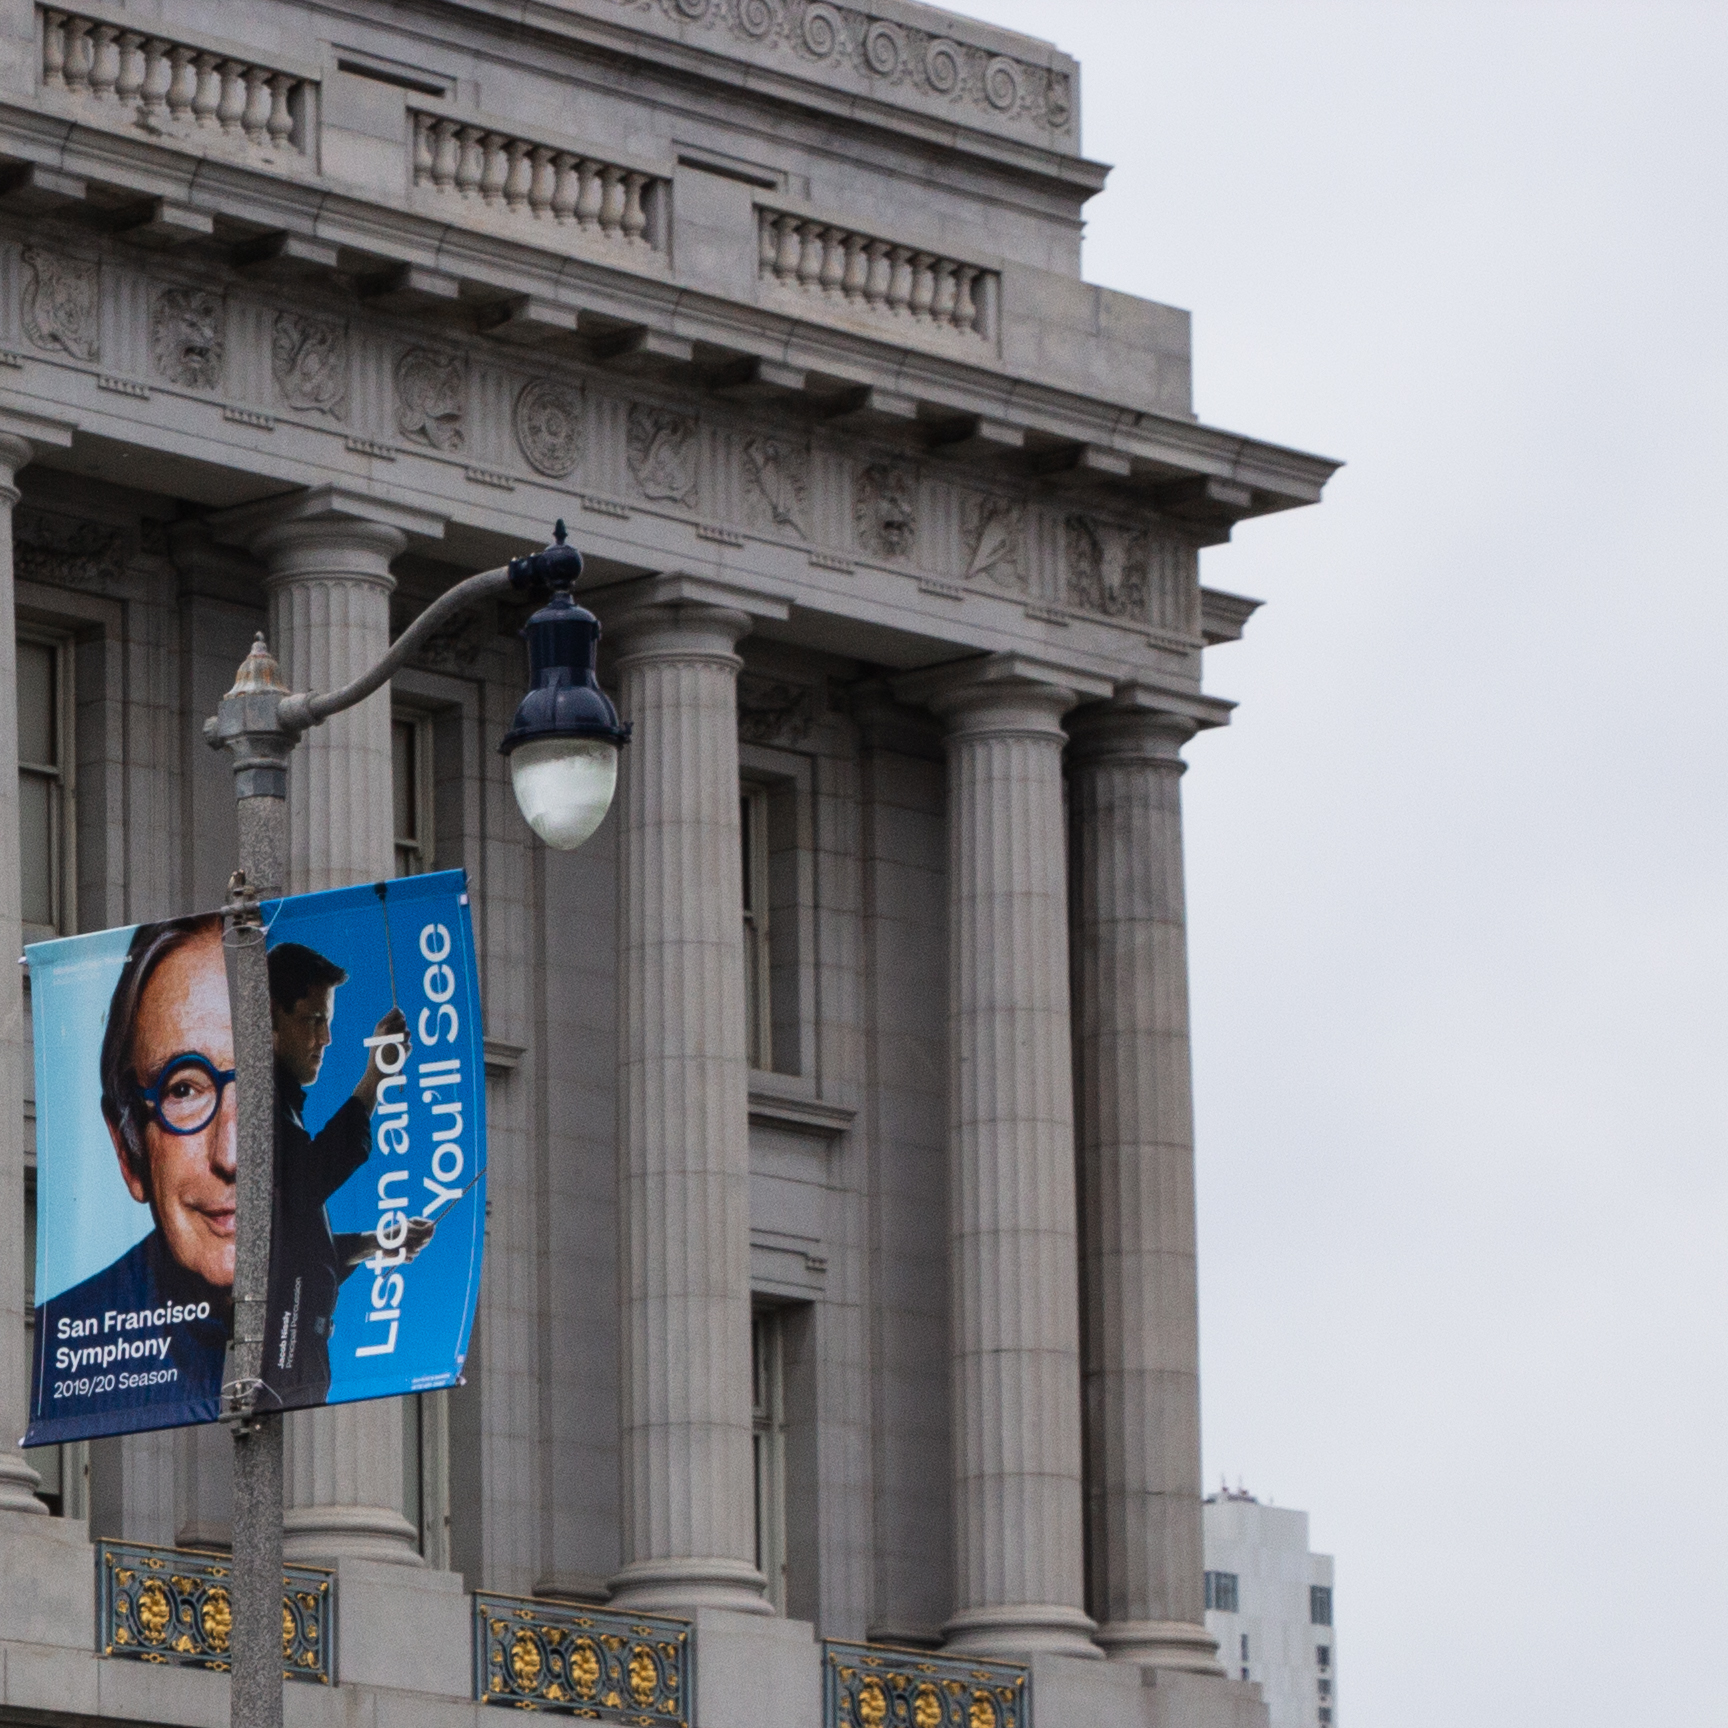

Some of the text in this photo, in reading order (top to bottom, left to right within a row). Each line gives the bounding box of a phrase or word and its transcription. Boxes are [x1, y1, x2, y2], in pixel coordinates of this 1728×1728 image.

[418, 923, 464, 1218] You'll See
[355, 1033, 411, 1358] Listen and
[56, 1300, 211, 1341] San Francisco
[55, 1335, 172, 1372] Symphony
[53, 1366, 178, 1398] 2019/20 Season
